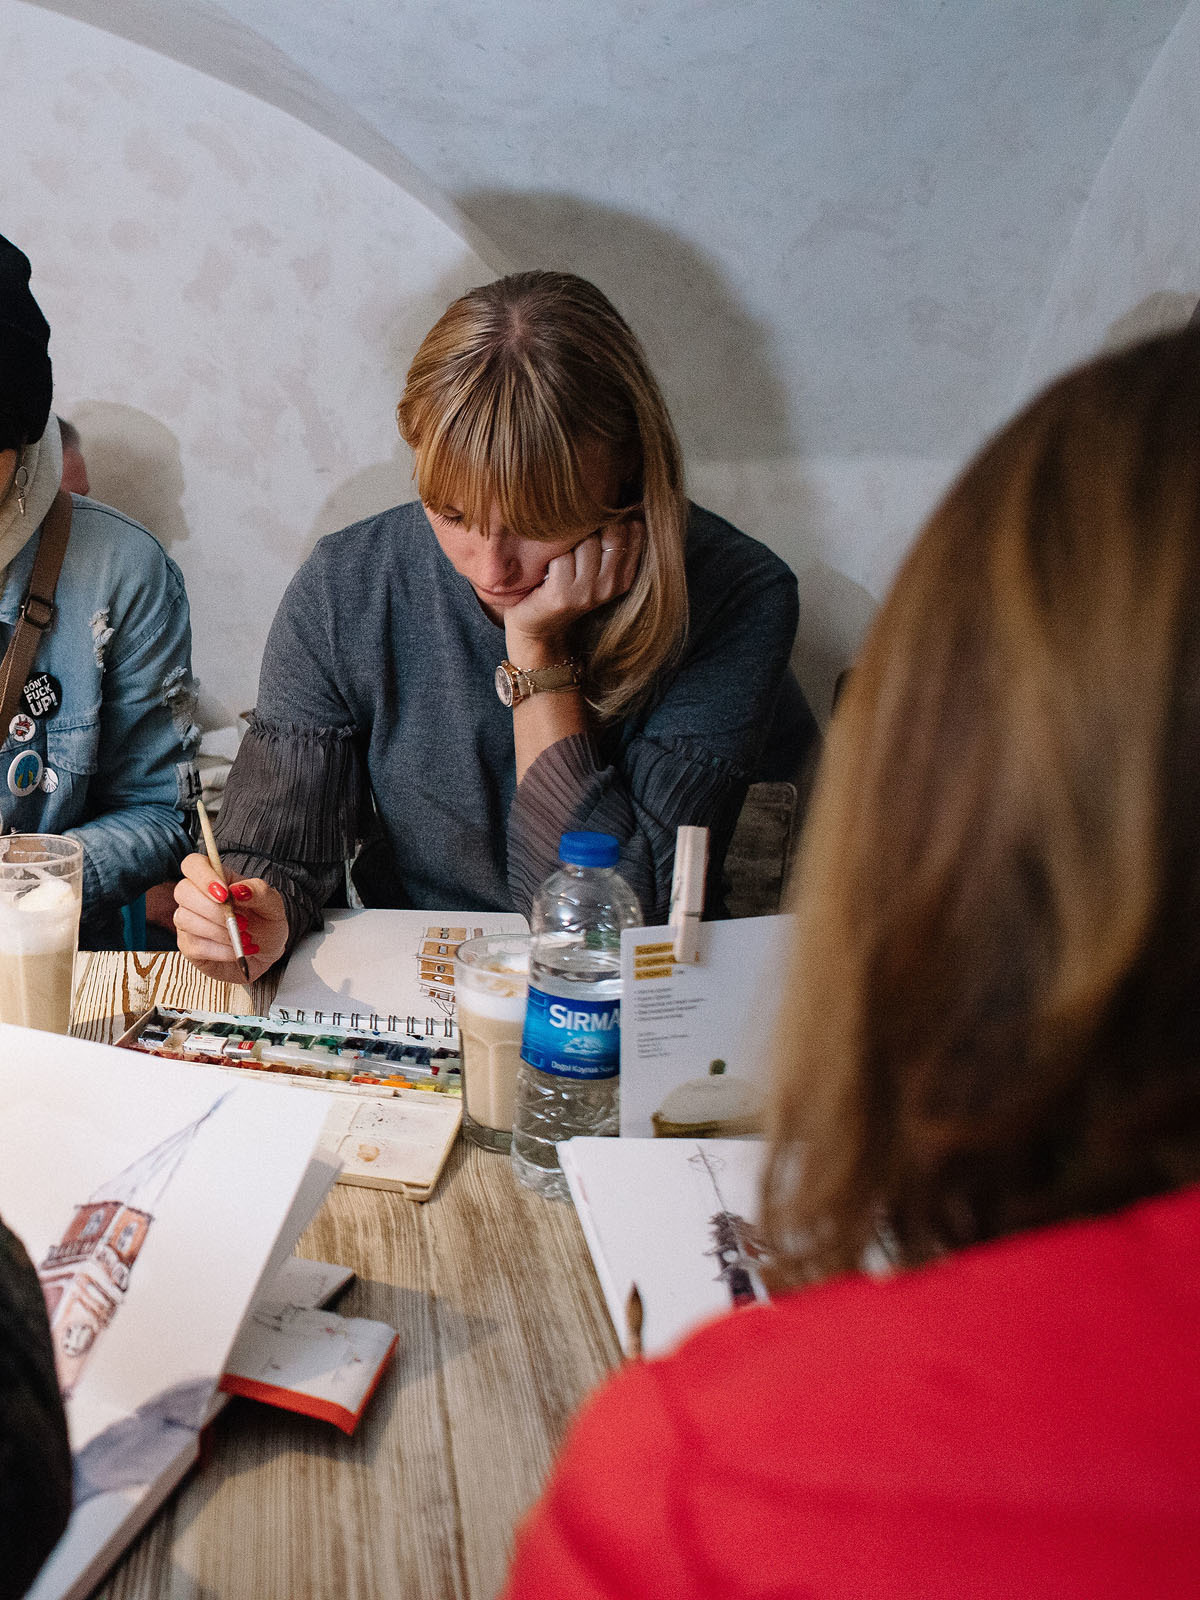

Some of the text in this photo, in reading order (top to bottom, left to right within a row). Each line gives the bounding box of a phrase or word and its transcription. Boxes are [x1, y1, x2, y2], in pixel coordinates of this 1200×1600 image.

[23, 674, 48, 694] DON'T
[26, 683, 52, 704] FUCK
[30, 692, 58, 716] UP!
[549, 1004, 620, 1032] SIRMA
